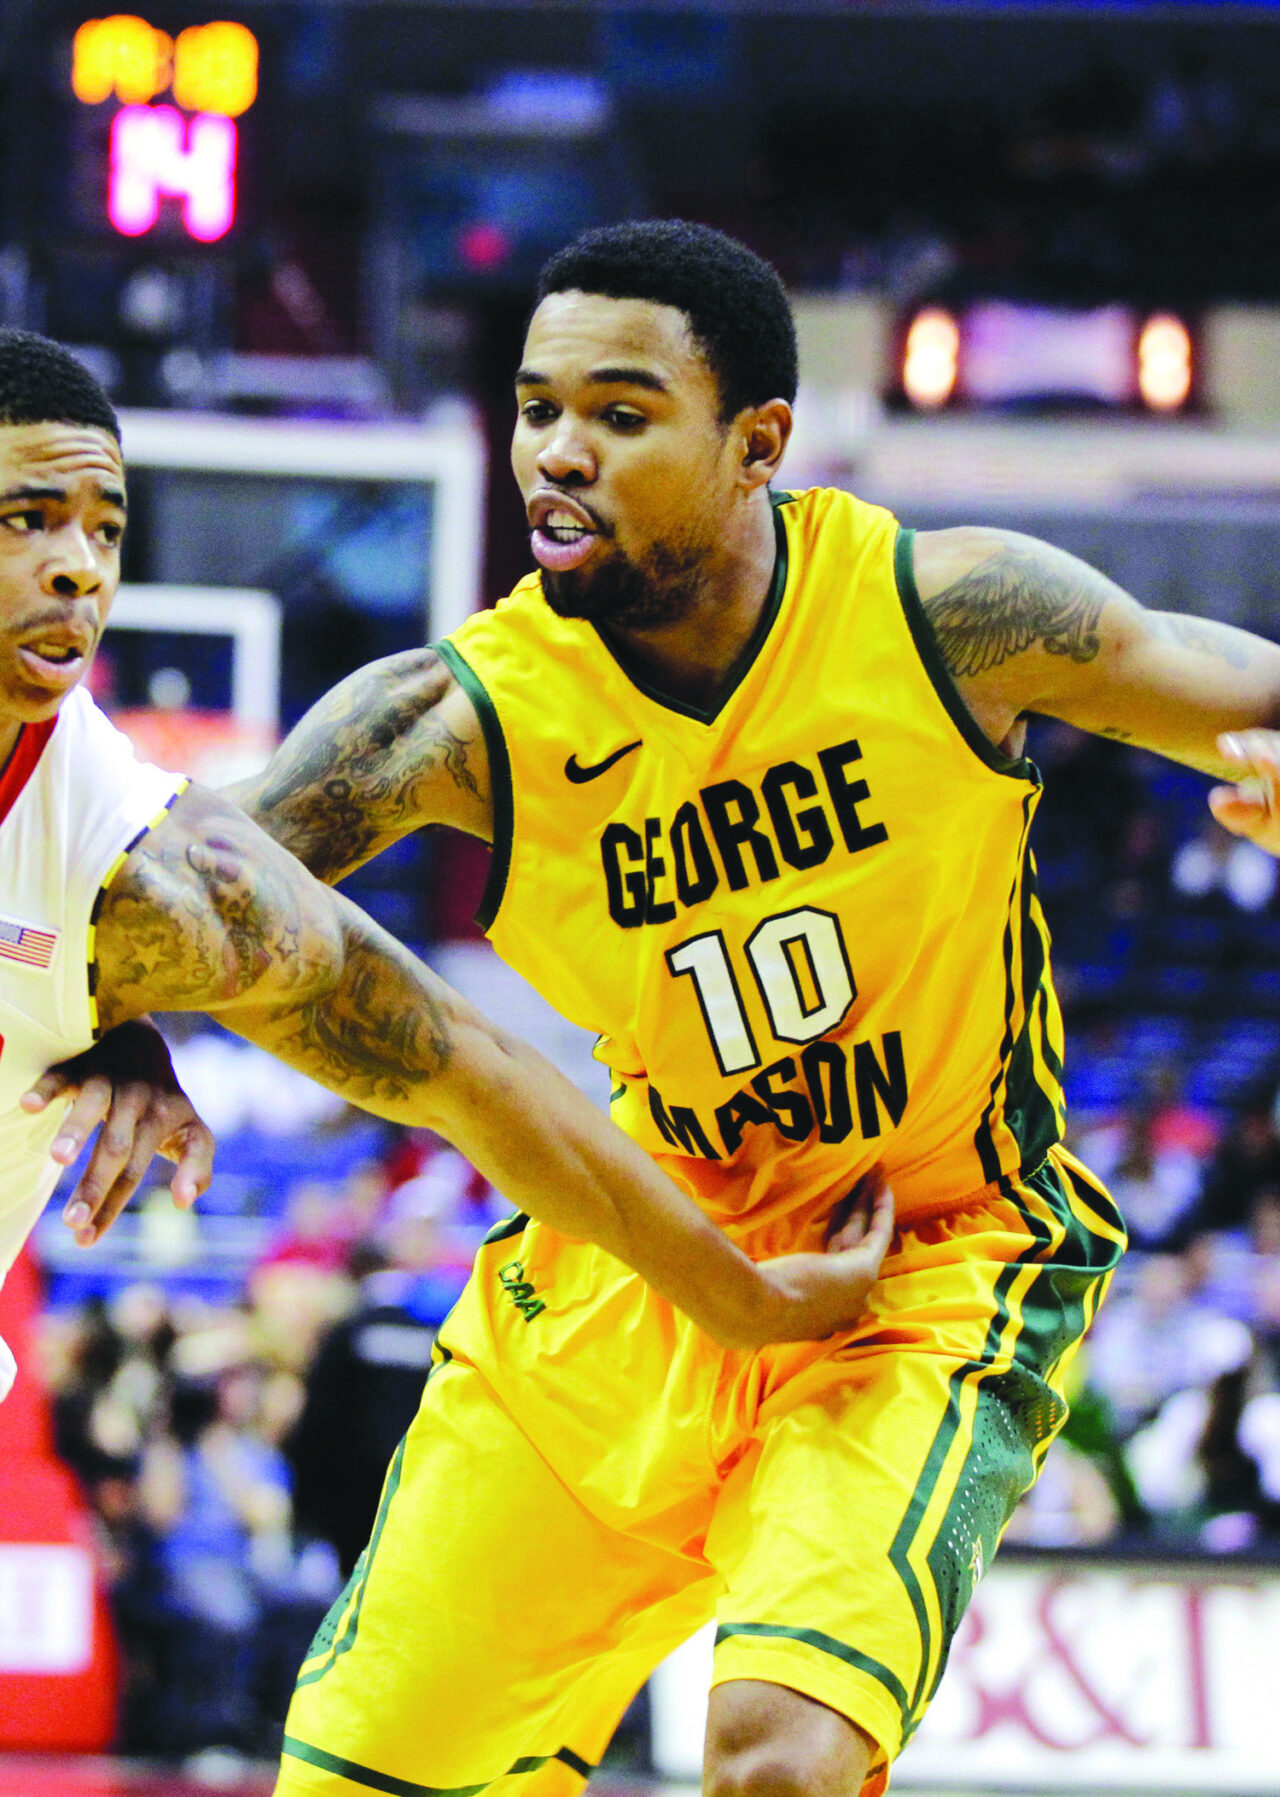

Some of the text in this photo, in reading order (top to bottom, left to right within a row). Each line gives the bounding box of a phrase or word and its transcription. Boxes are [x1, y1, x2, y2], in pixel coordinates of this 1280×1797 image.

[600, 739, 889, 928] GEORGE
[664, 905, 858, 1077] 10
[648, 1031, 908, 1160] MASON
[499, 1261, 547, 1324] CAA
